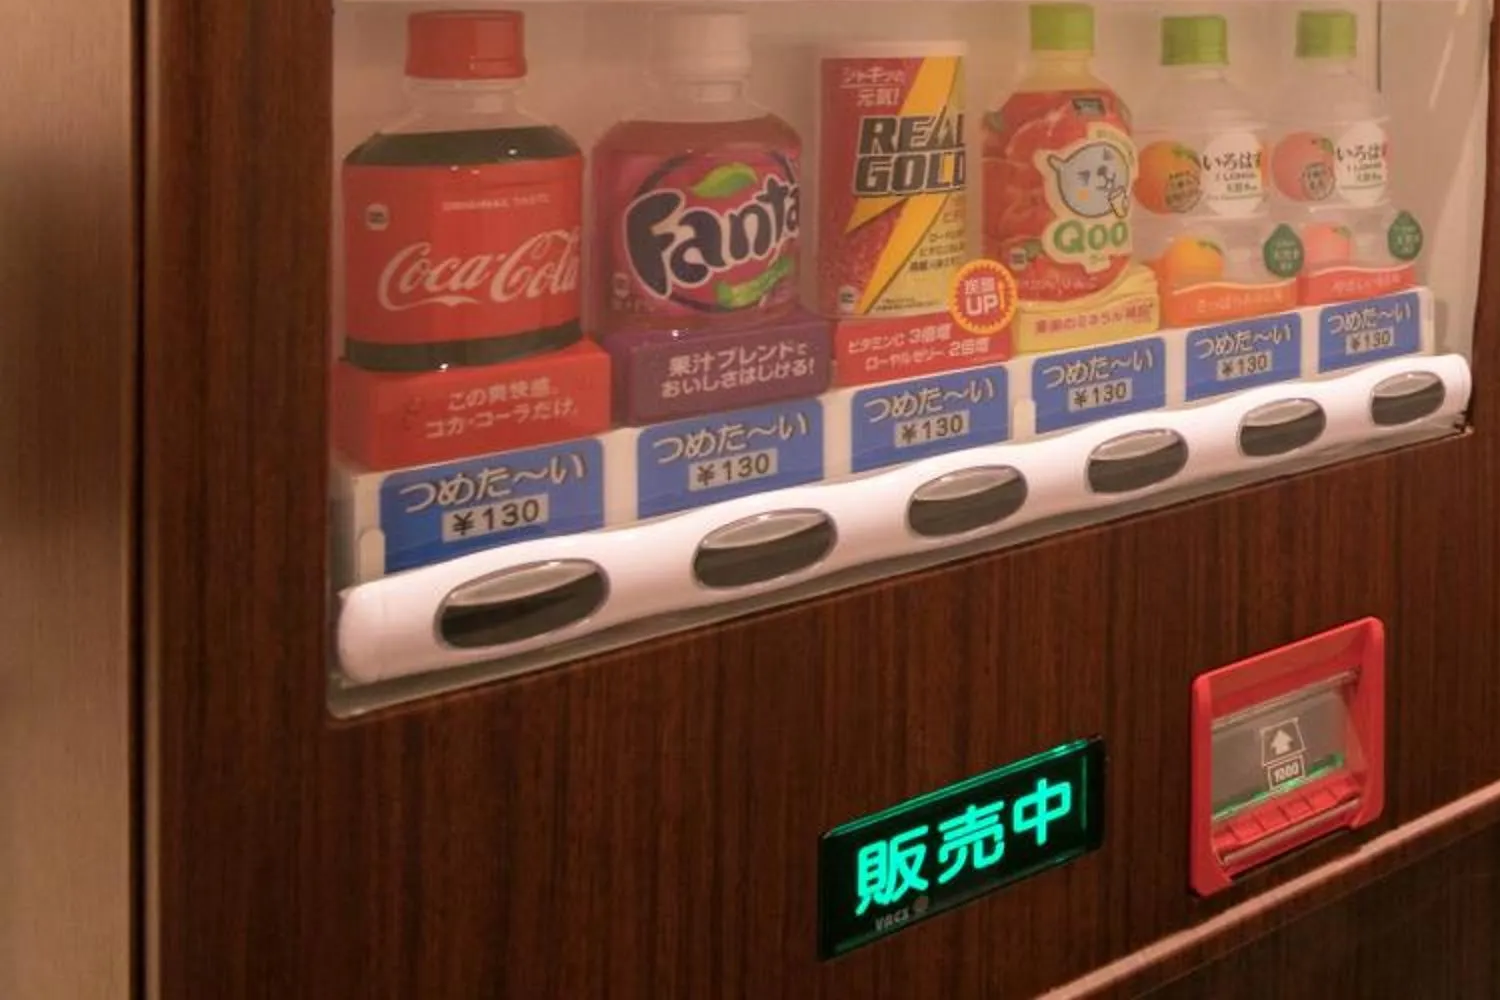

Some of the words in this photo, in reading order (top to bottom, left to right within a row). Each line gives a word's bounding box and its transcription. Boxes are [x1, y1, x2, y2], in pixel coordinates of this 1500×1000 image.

[623, 173, 799, 300] Fanta
[1053, 219, 1129, 255] Qoo
[966, 294, 999, 316] UP
[1221, 354, 1268, 377] ¥130
[1072, 381, 1128, 408] ¥130
[900, 414, 964, 444] ¥130
[696, 452, 771, 487] ¥130
[451, 498, 540, 536] ¥130
[855, 777, 1073, 917] 販売中
